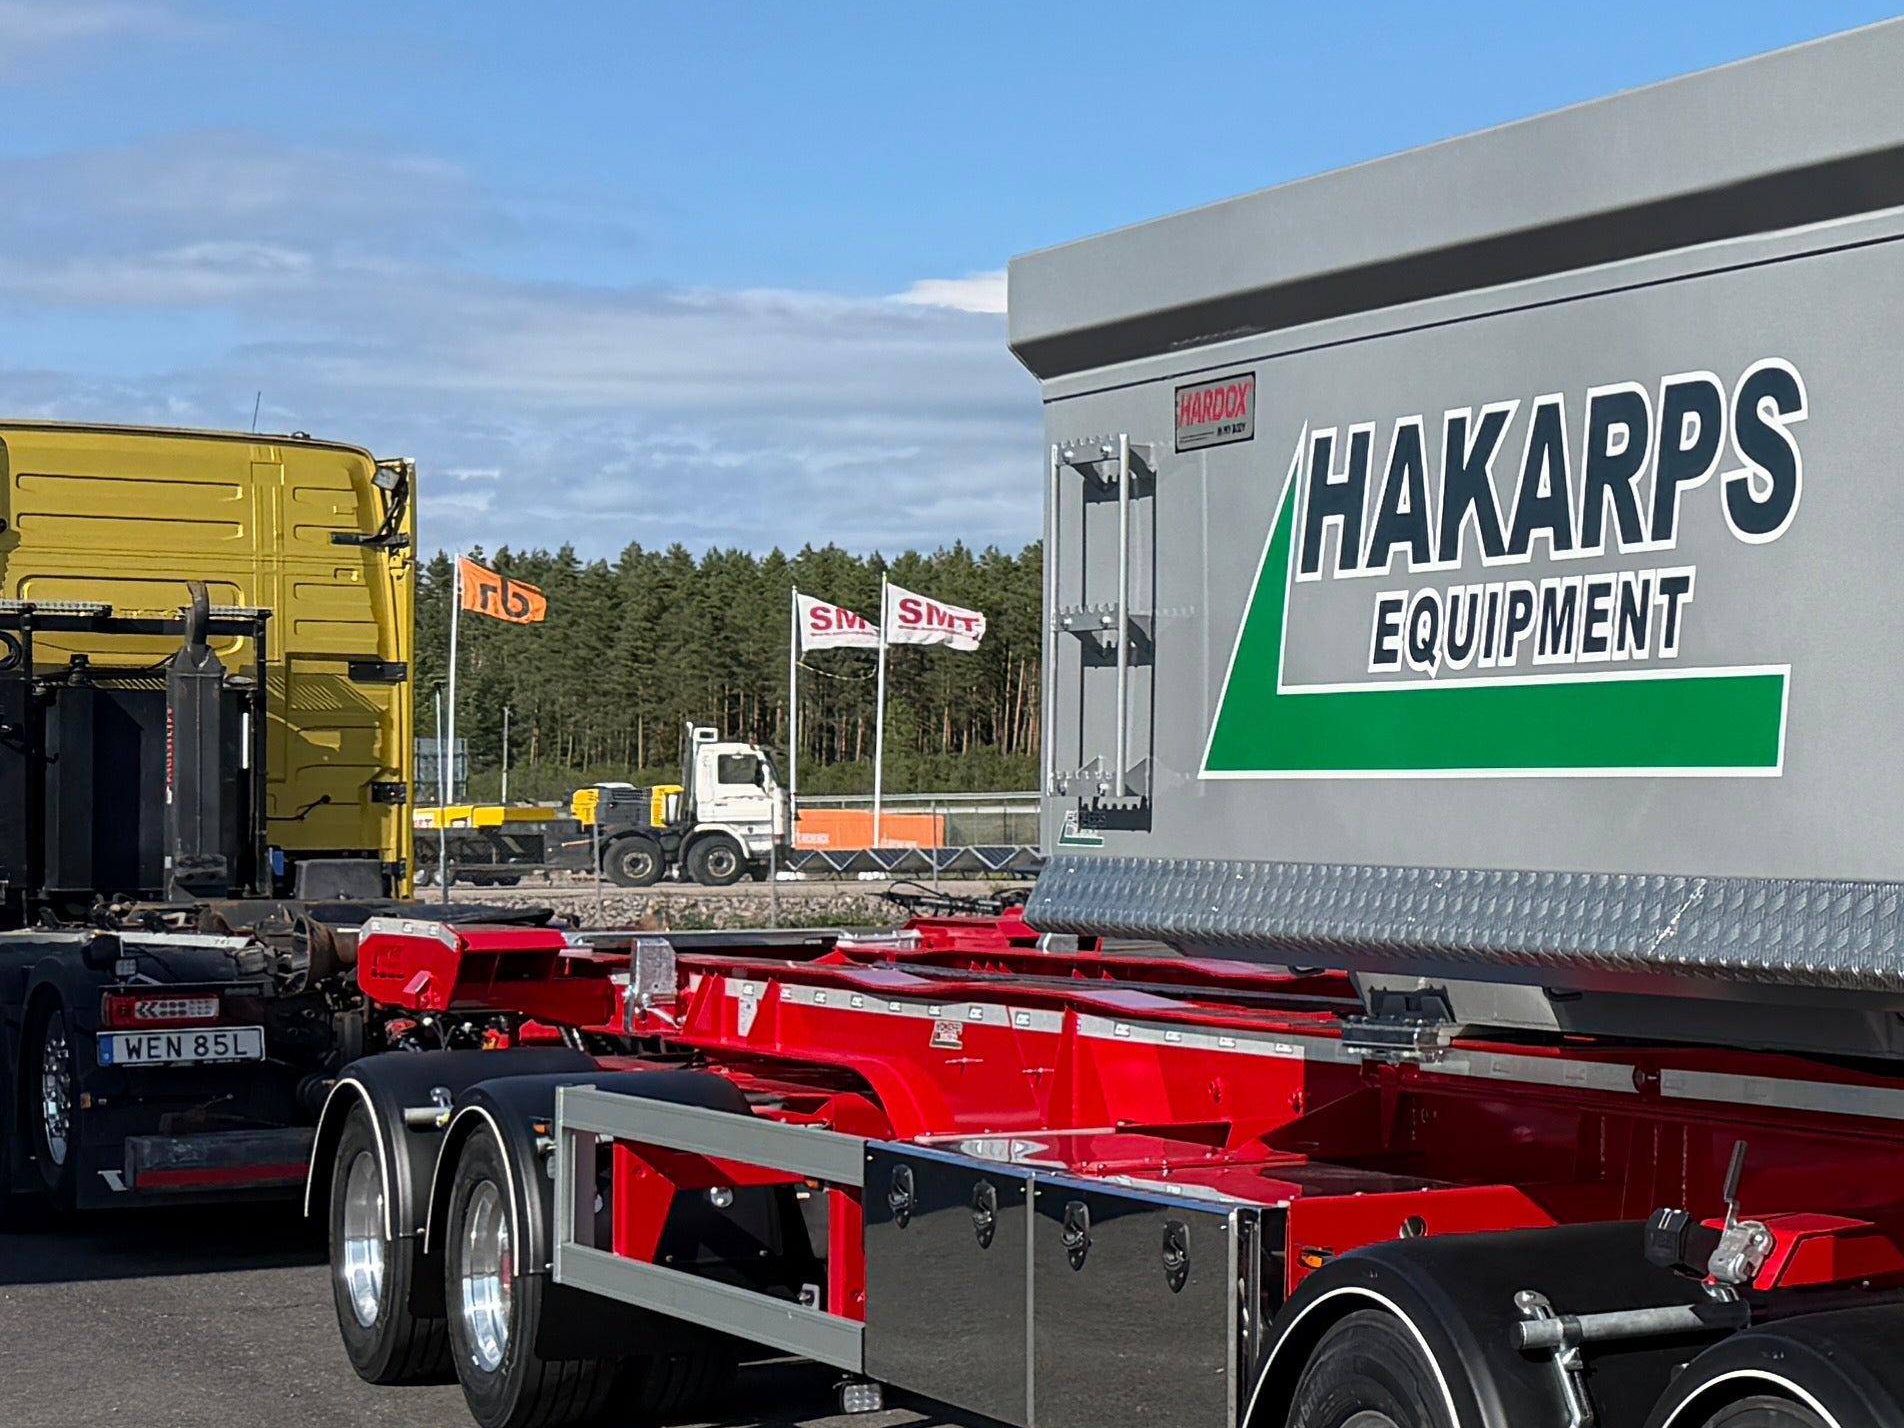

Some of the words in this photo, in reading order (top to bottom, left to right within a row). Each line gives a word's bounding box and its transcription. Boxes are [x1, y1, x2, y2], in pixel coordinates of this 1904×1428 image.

[1178, 383, 1248, 428] HARDOX
[1296, 358, 1808, 581] HAKARPS
[480, 576, 530, 618] rb
[1368, 566, 1696, 678] EQUIPMENT
[125, 1036, 182, 1060] WEN
[193, 1033, 248, 1057] 85L
